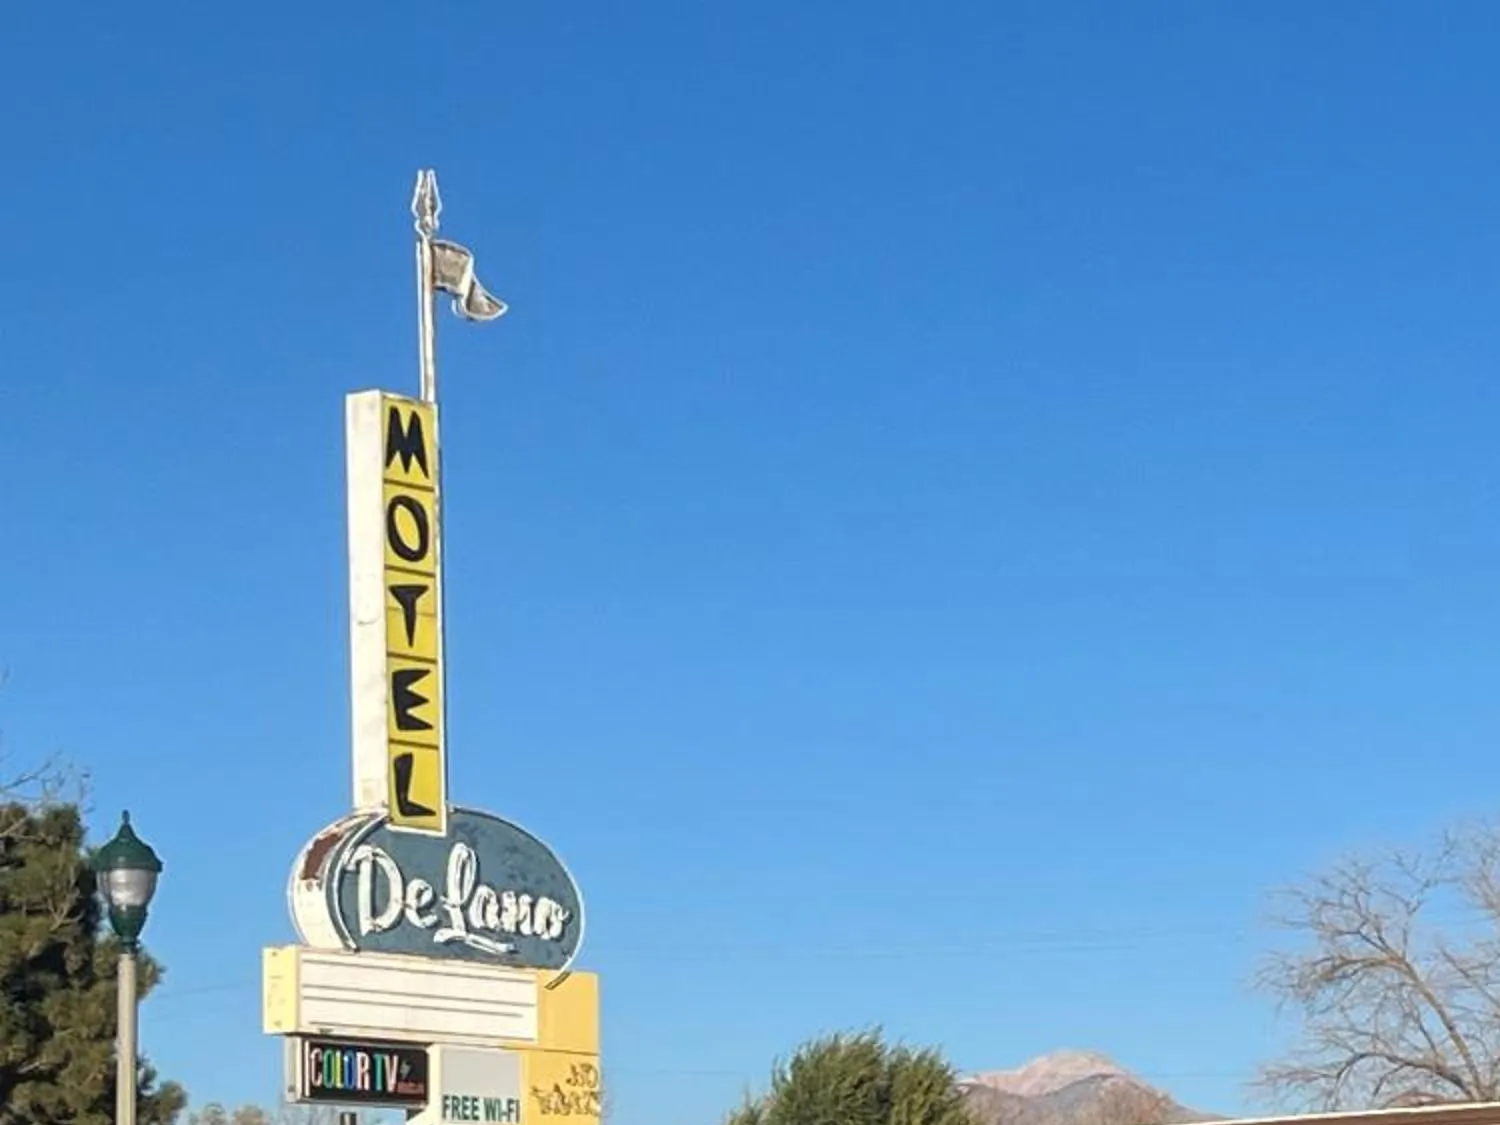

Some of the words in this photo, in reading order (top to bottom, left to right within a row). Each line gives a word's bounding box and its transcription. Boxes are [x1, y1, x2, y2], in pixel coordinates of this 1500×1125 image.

[385, 406, 437, 817] MOTEL
[310, 1047, 371, 1091] COLOR
[374, 1053, 398, 1093] TV
[442, 1094, 480, 1121] FREE
[483, 1097, 520, 1124] WI-FI
